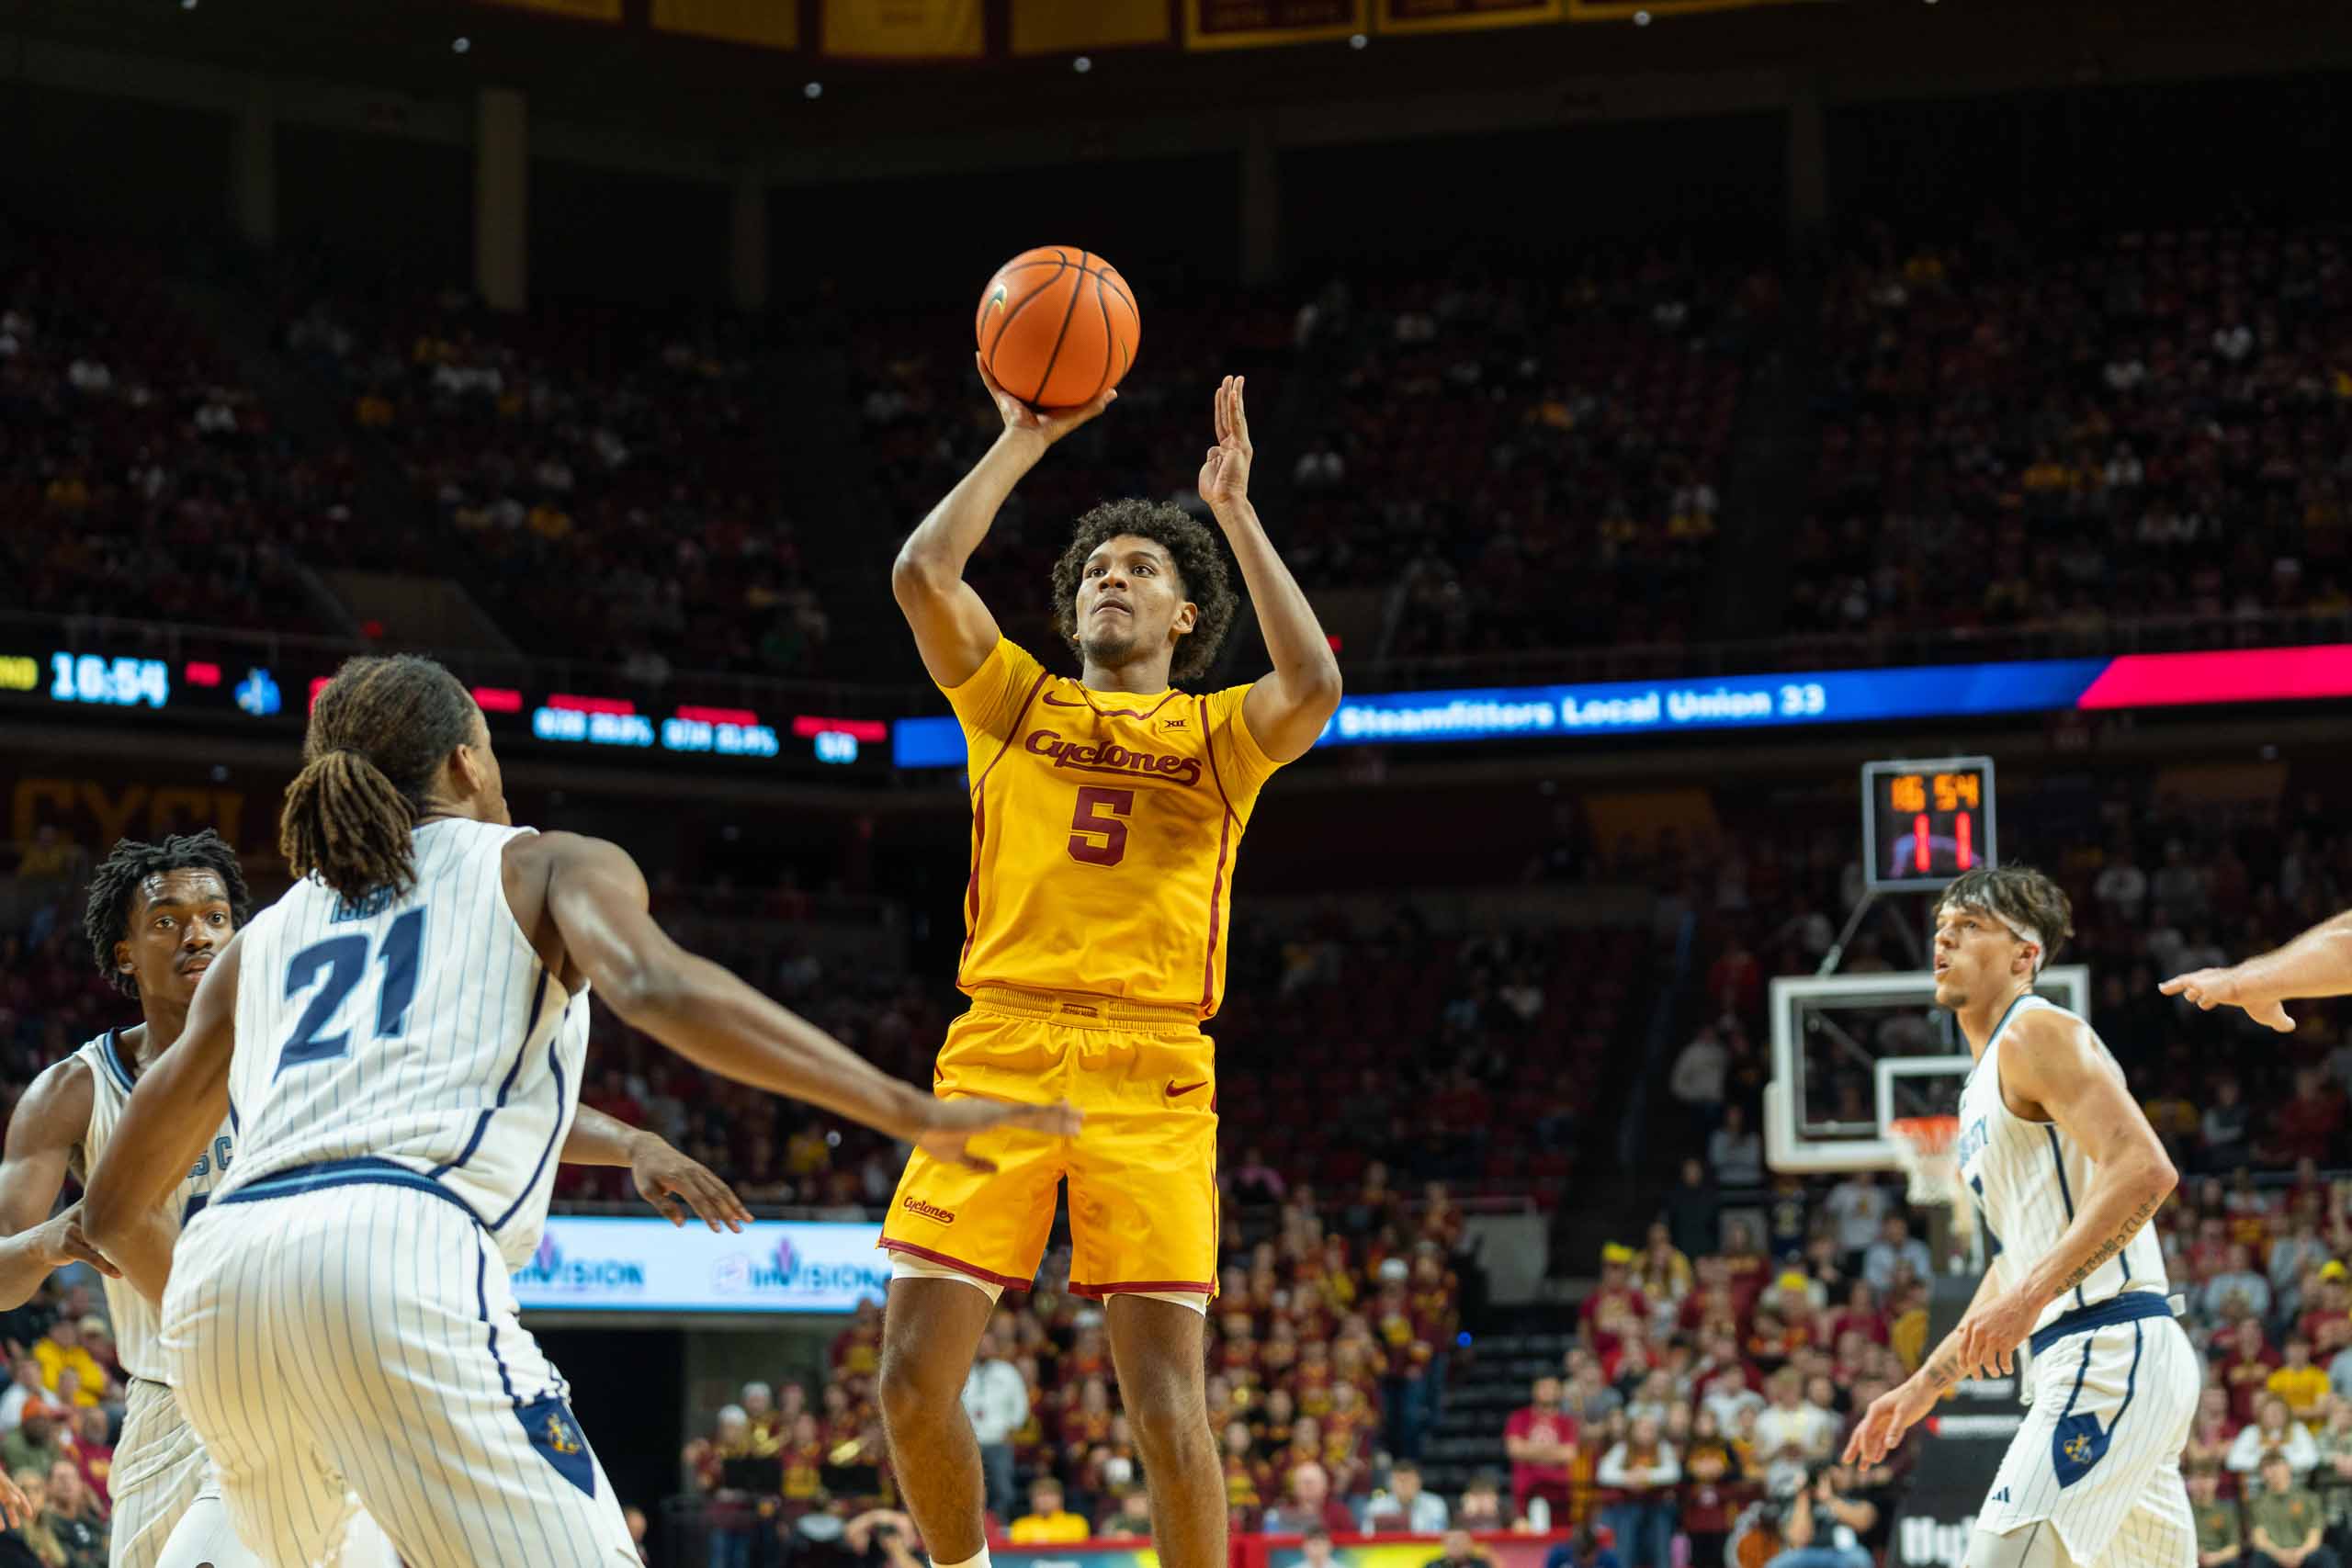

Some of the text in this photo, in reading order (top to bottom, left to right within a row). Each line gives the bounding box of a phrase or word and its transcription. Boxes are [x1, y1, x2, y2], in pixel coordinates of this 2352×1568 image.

[1339, 682, 1827, 738] Steamfitters Local Union 33
[1024, 729, 1203, 786] Cyclones
[1067, 785, 1135, 868] 5
[273, 904, 429, 1088] 21
[904, 1197, 956, 1224] Cyclones
